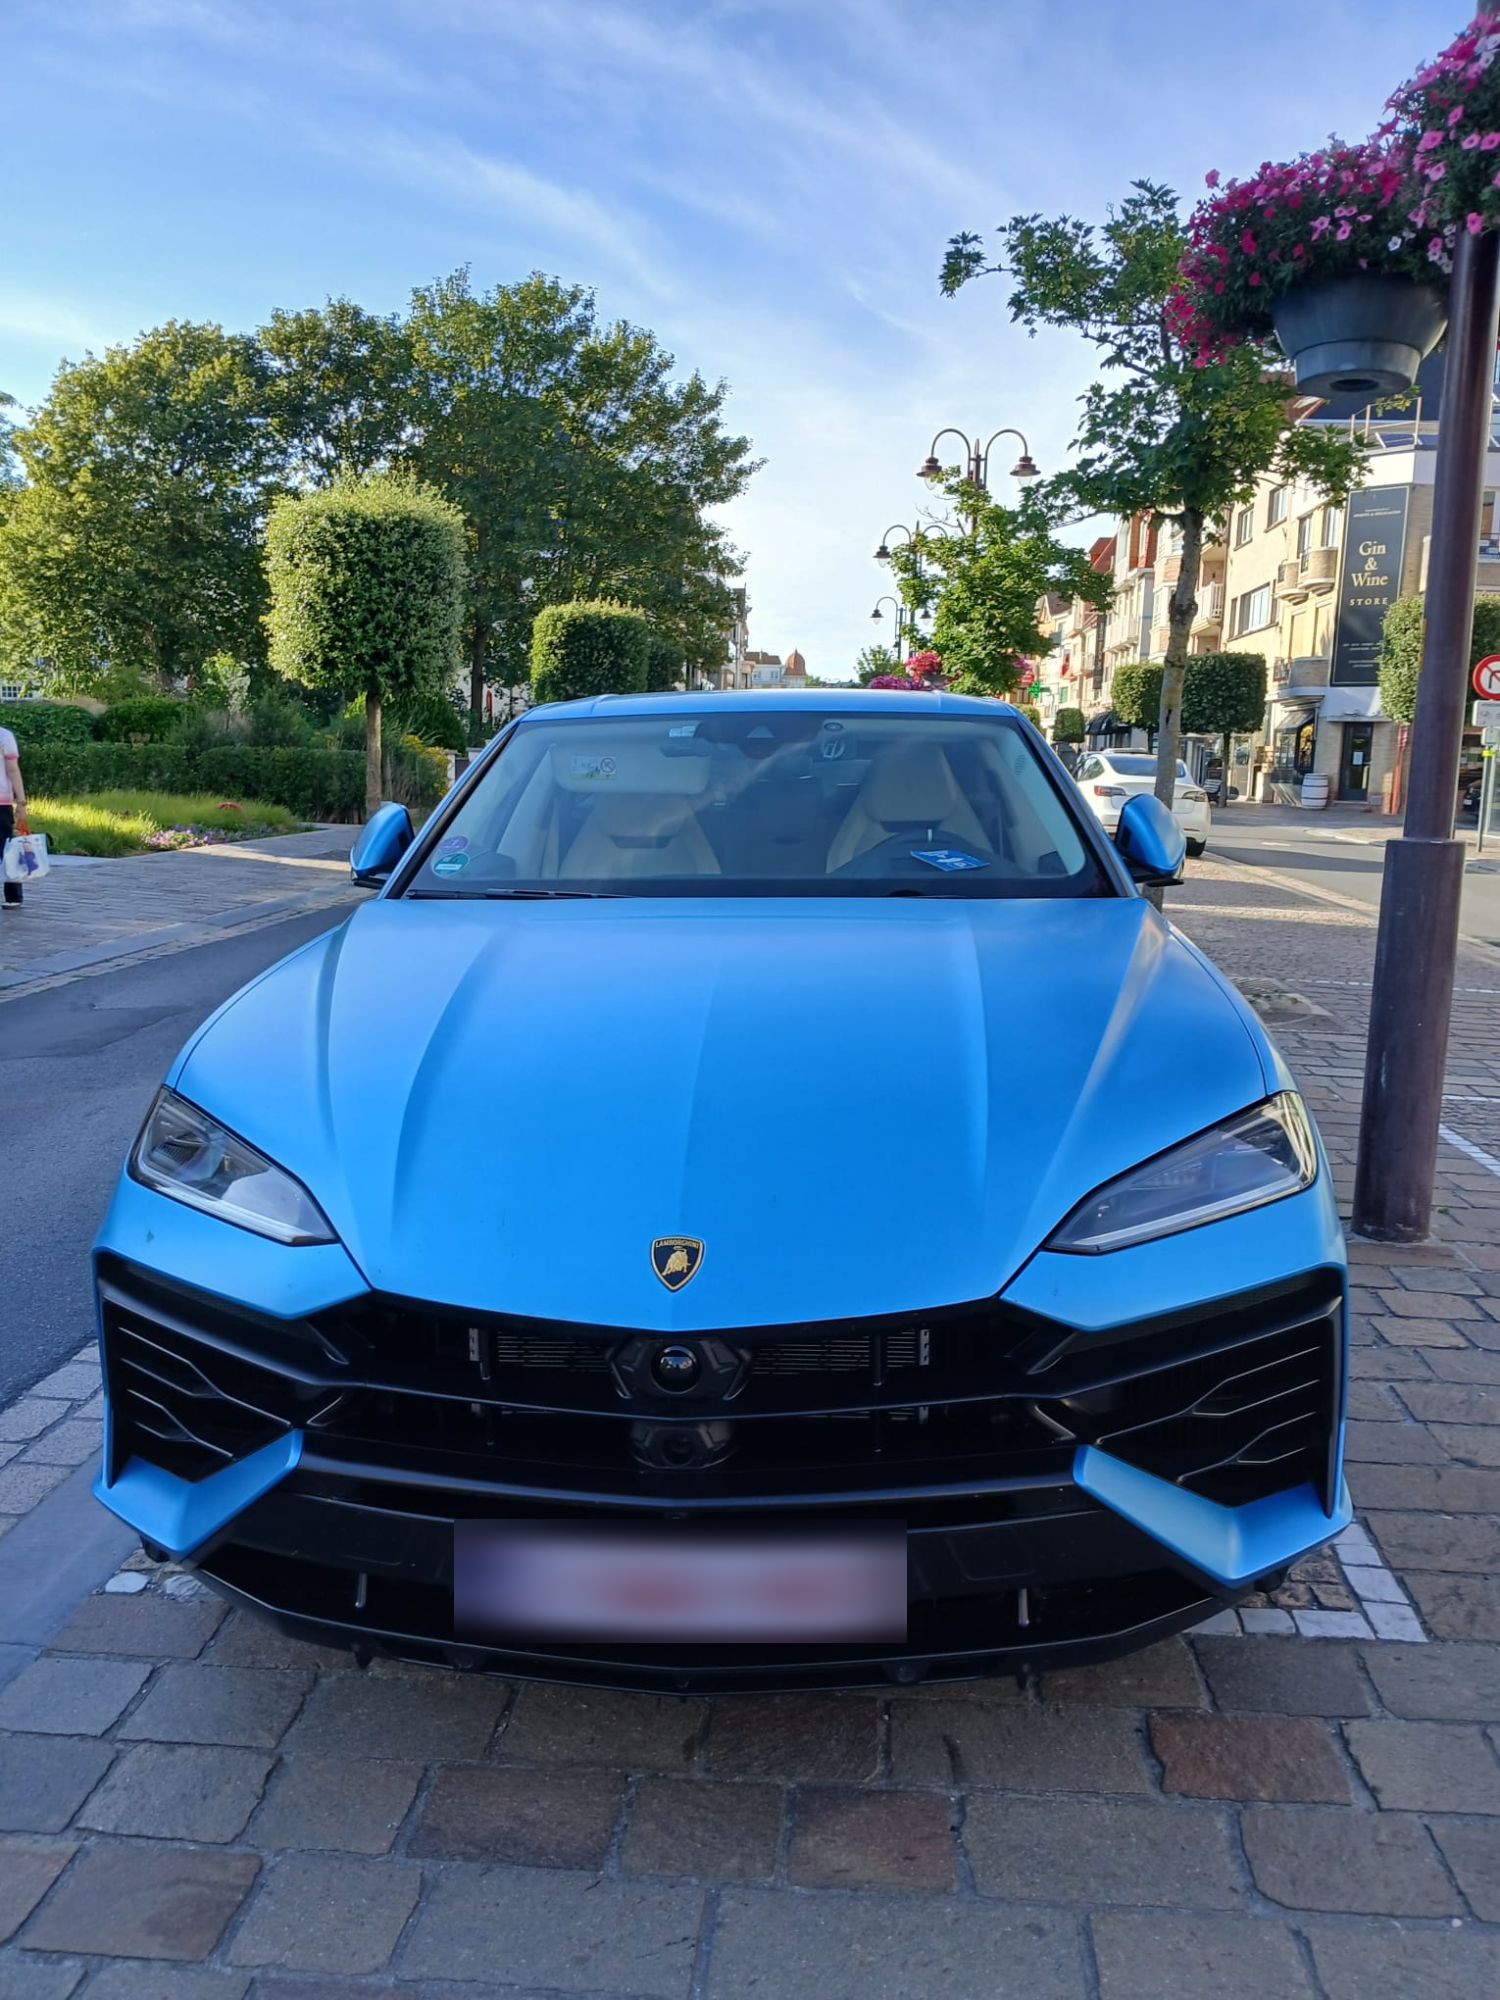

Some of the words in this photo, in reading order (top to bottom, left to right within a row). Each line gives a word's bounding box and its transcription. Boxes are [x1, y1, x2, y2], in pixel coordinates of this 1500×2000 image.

[1359, 541, 1386, 556] Gin
[1365, 557, 1379, 571] &
[1351, 572, 1388, 587] Wine
[1350, 597, 1389, 606] STORE
